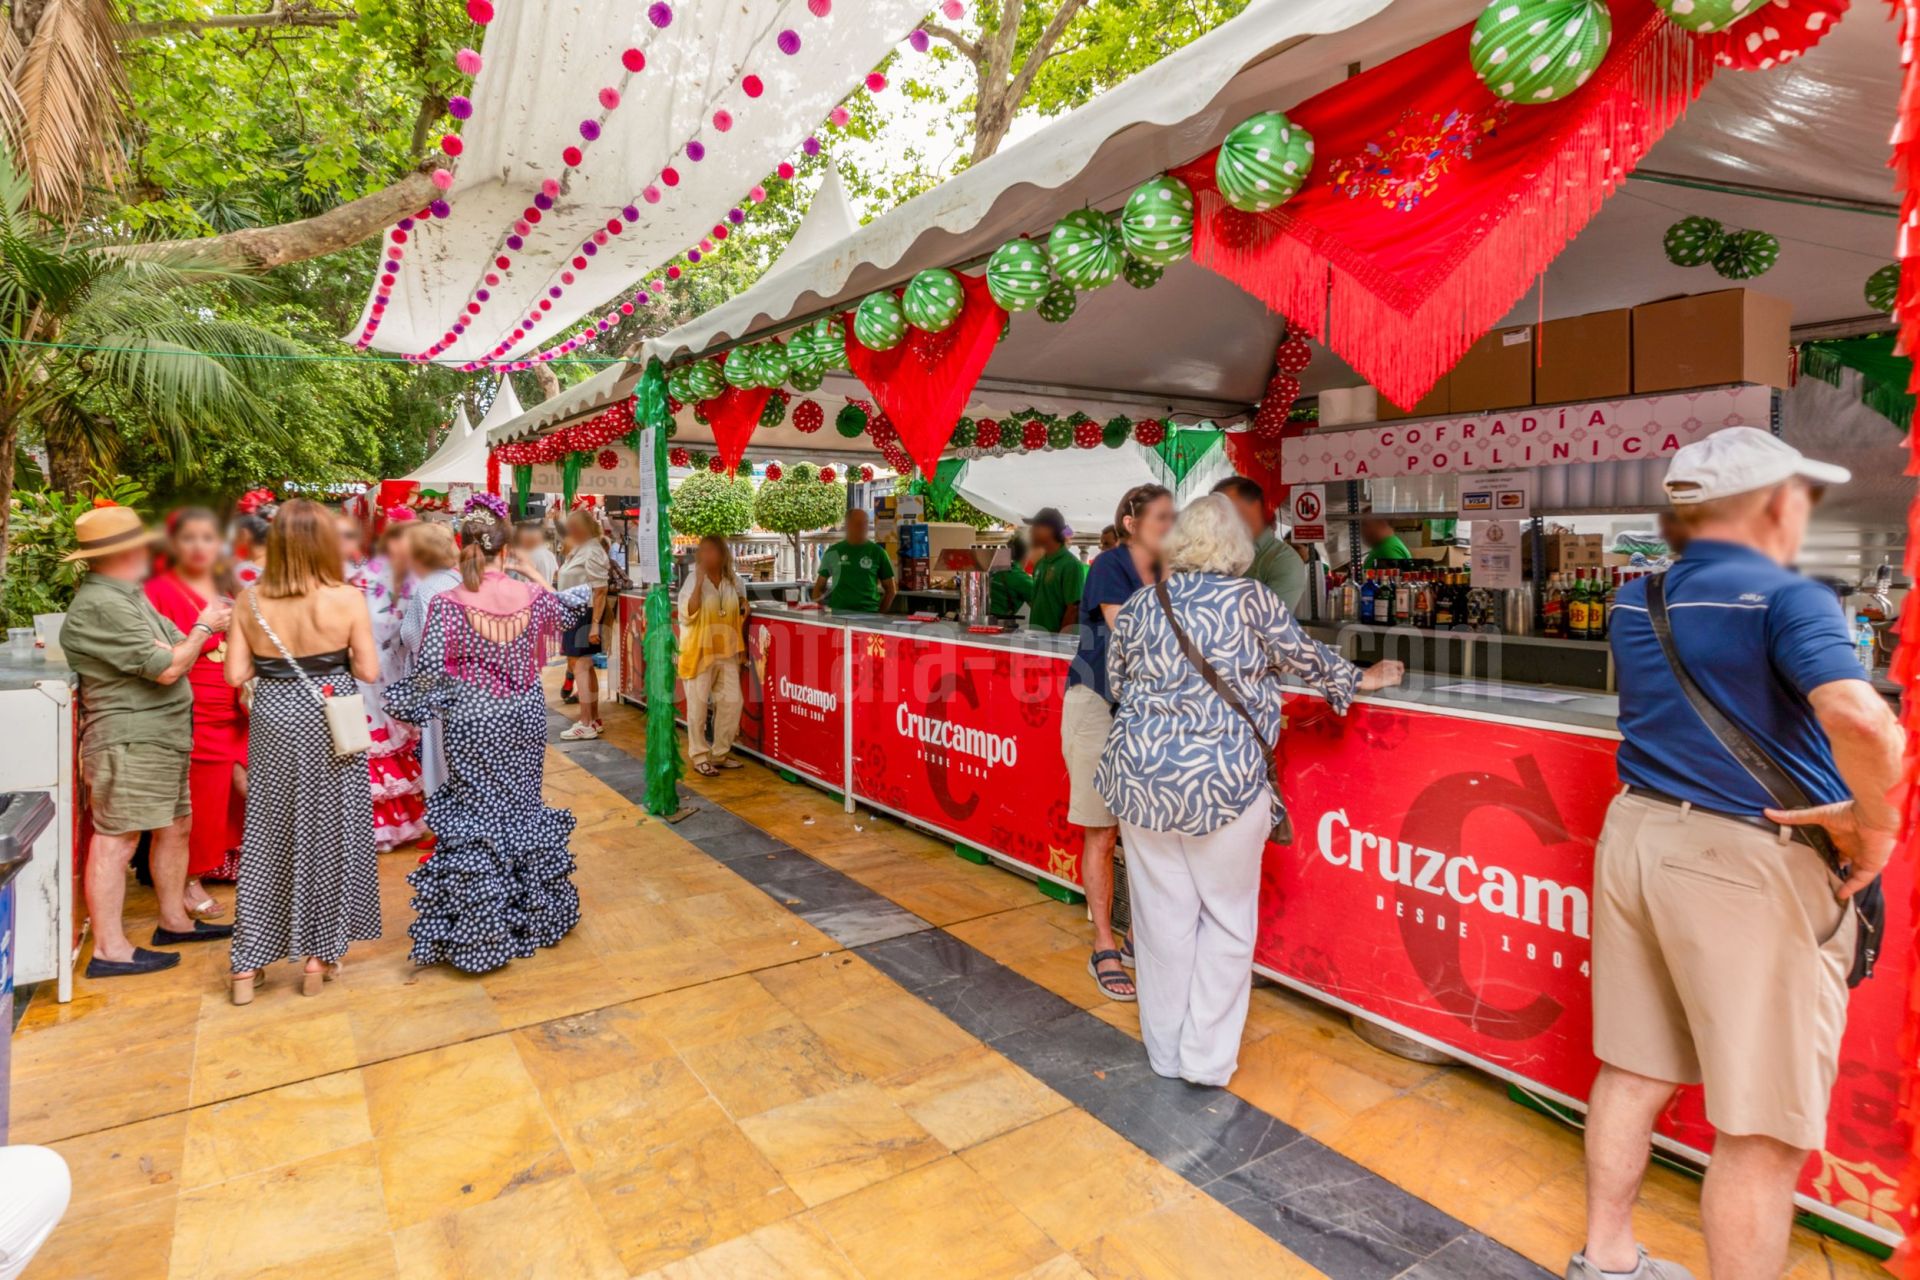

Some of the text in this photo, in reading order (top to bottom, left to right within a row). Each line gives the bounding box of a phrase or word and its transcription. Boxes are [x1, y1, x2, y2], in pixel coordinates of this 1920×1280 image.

[1381, 409, 1606, 447] COFRADÍA
[1334, 434, 1681, 476] LA POLLINICA
[1468, 497, 1487, 505] VISA
[780, 675, 837, 713] Cruzcampo
[896, 701, 1017, 768] Cruzcampo
[1317, 808, 1591, 940] Cruzcam
[1376, 895, 1590, 979] DESDE 1904
